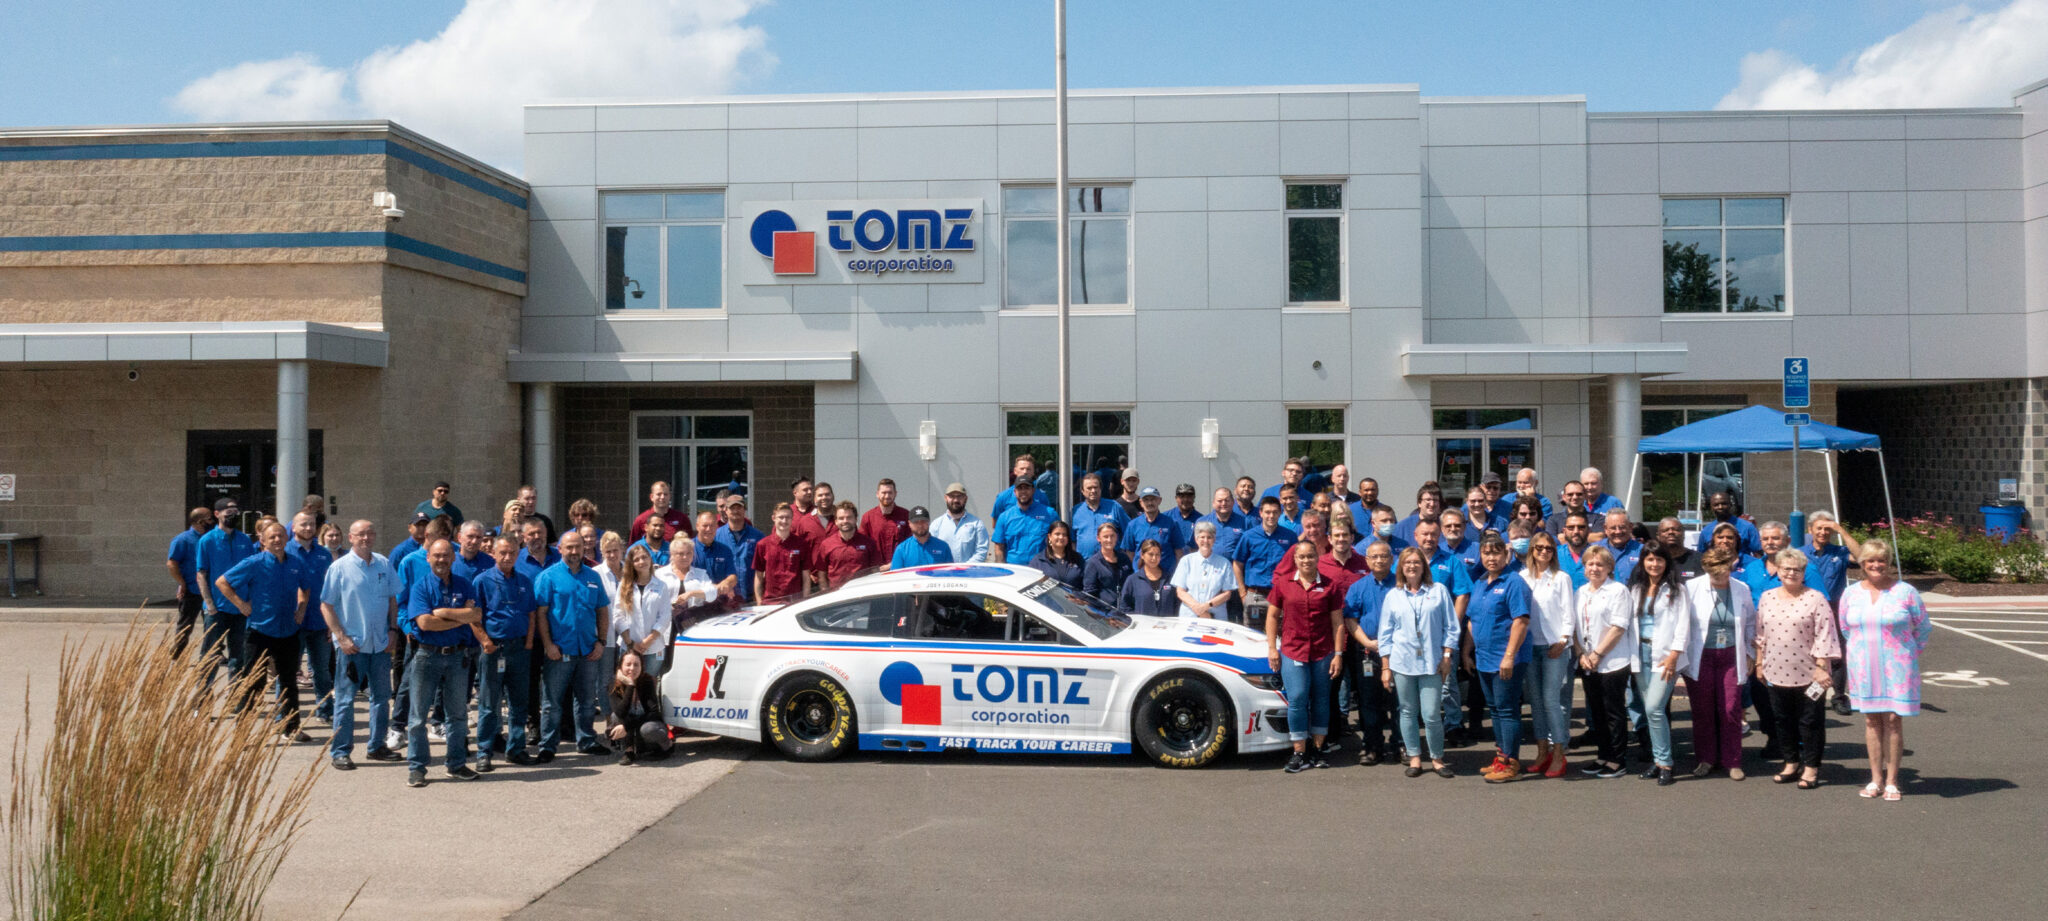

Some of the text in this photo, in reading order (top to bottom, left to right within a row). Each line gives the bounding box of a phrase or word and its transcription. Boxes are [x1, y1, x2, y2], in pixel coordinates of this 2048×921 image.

[826, 208, 975, 252] TOMZ
[847, 254, 954, 275] corporation
[951, 664, 1090, 705] TOMZ
[1149, 678, 1185, 700] EAGLE
[673, 706, 750, 720] TOMZ.COM
[769, 704, 785, 742] EAGLE
[971, 708, 1070, 726] corporation
[939, 737, 1113, 753] FAST TRACK YOUR CAREER
